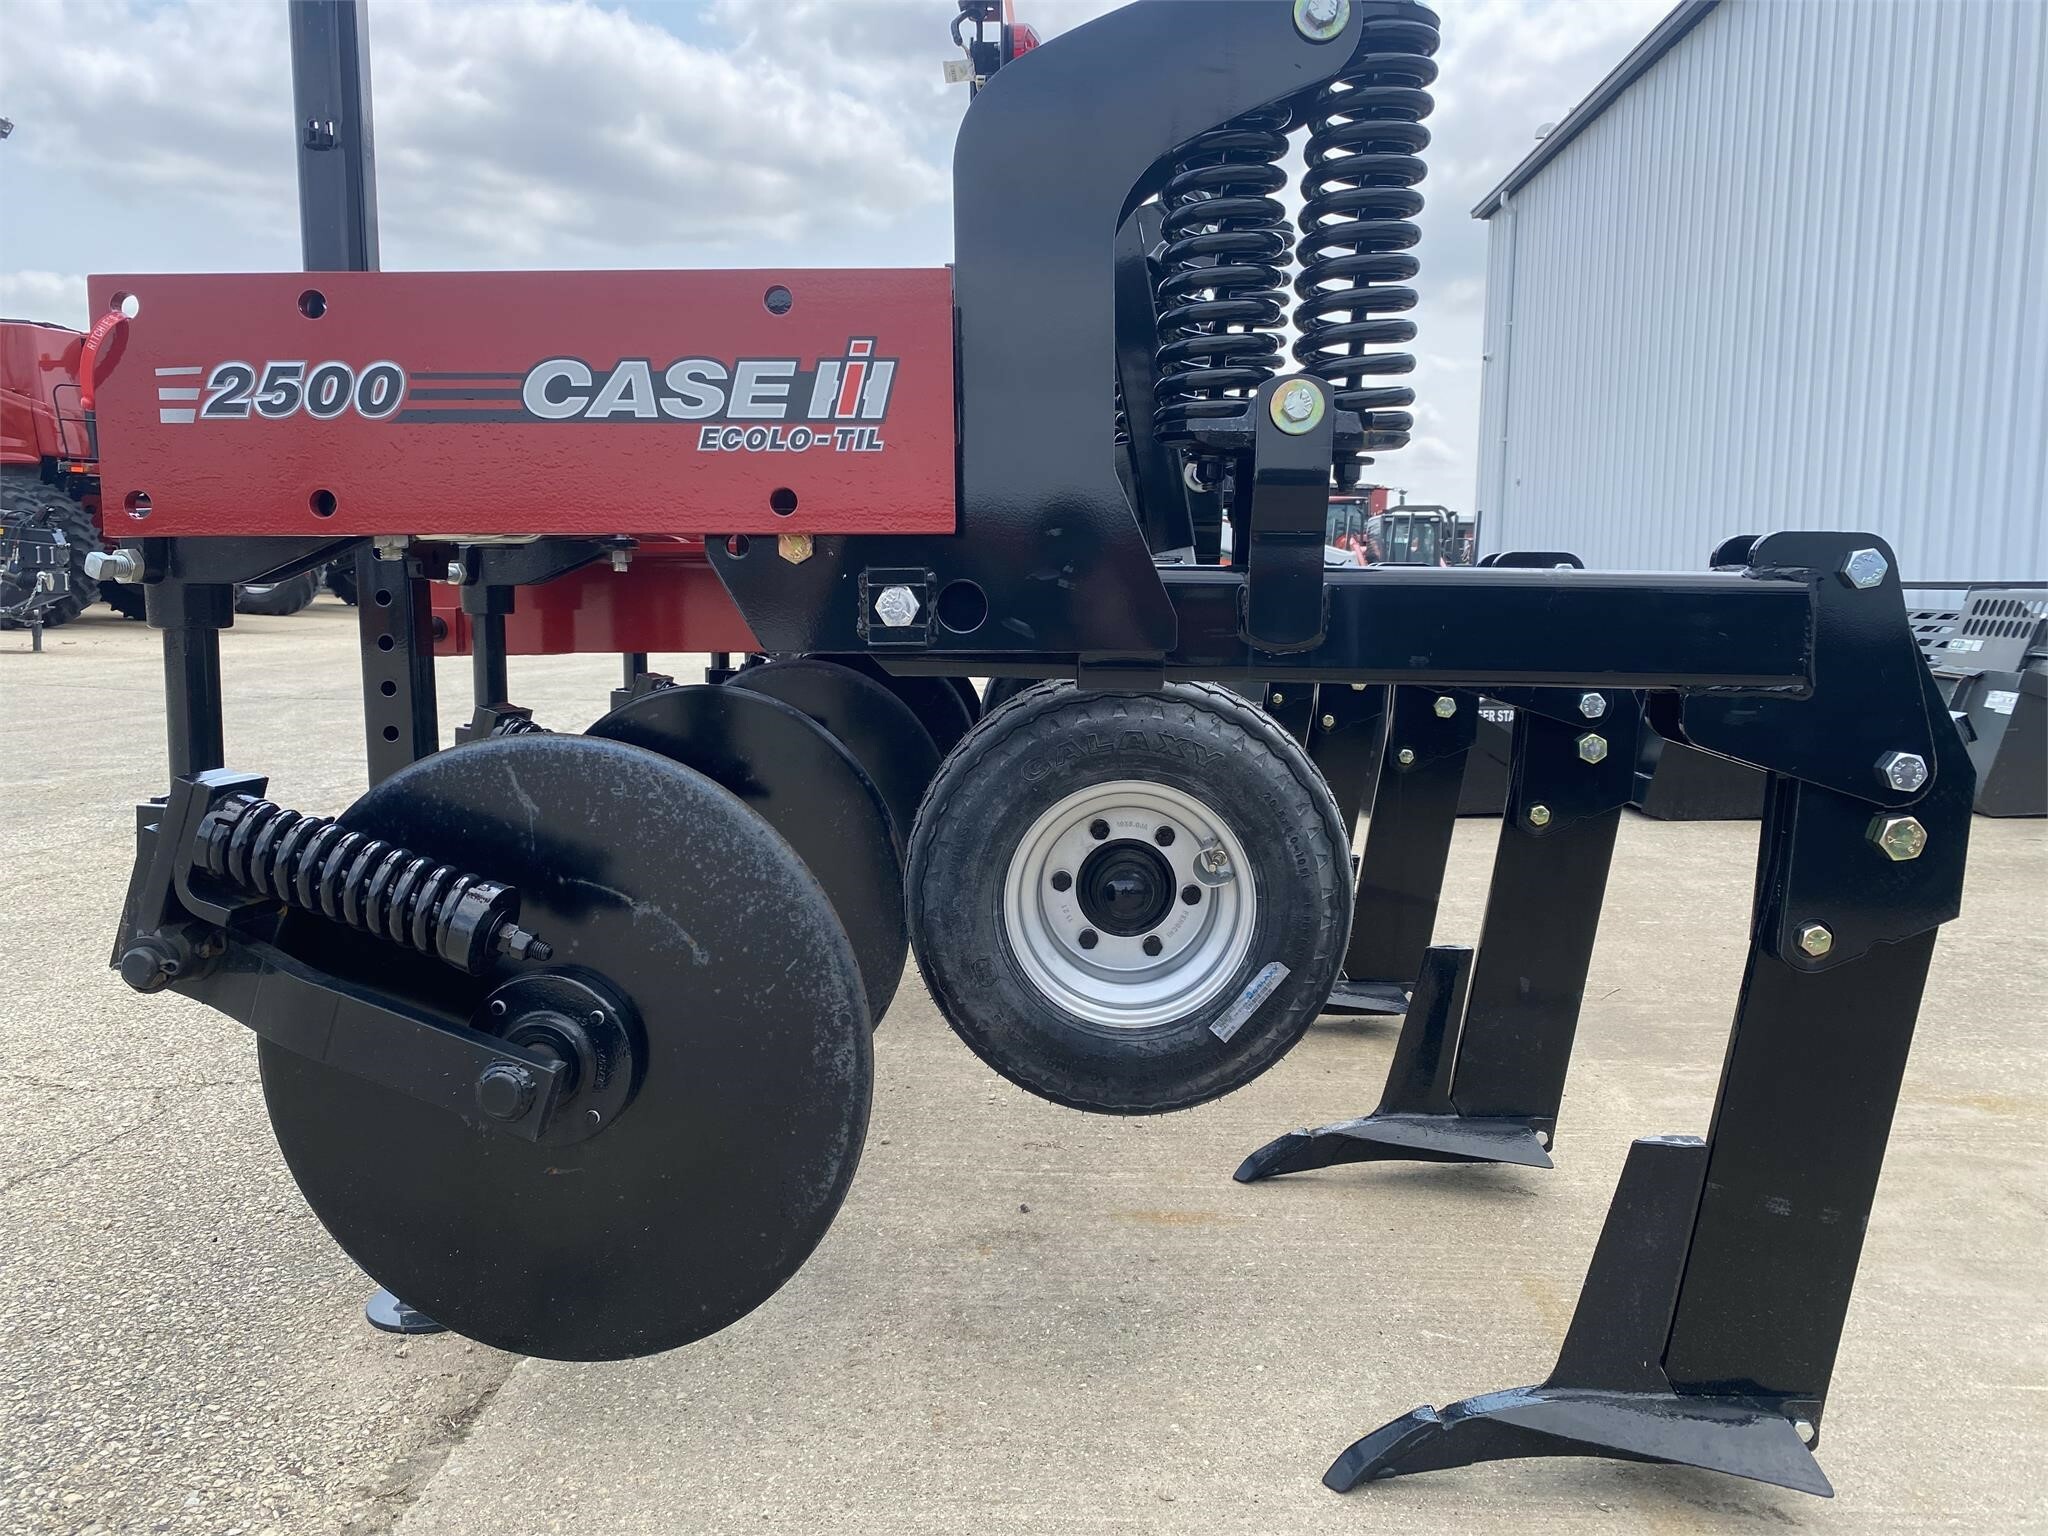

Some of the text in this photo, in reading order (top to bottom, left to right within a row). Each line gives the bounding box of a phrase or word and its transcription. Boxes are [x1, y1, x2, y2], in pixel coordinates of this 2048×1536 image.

[200, 361, 405, 420] 2500
[522, 358, 797, 420] CASE
[697, 426, 884, 452] ECOLO-TIL
[1021, 729, 1226, 782] GALAXY
